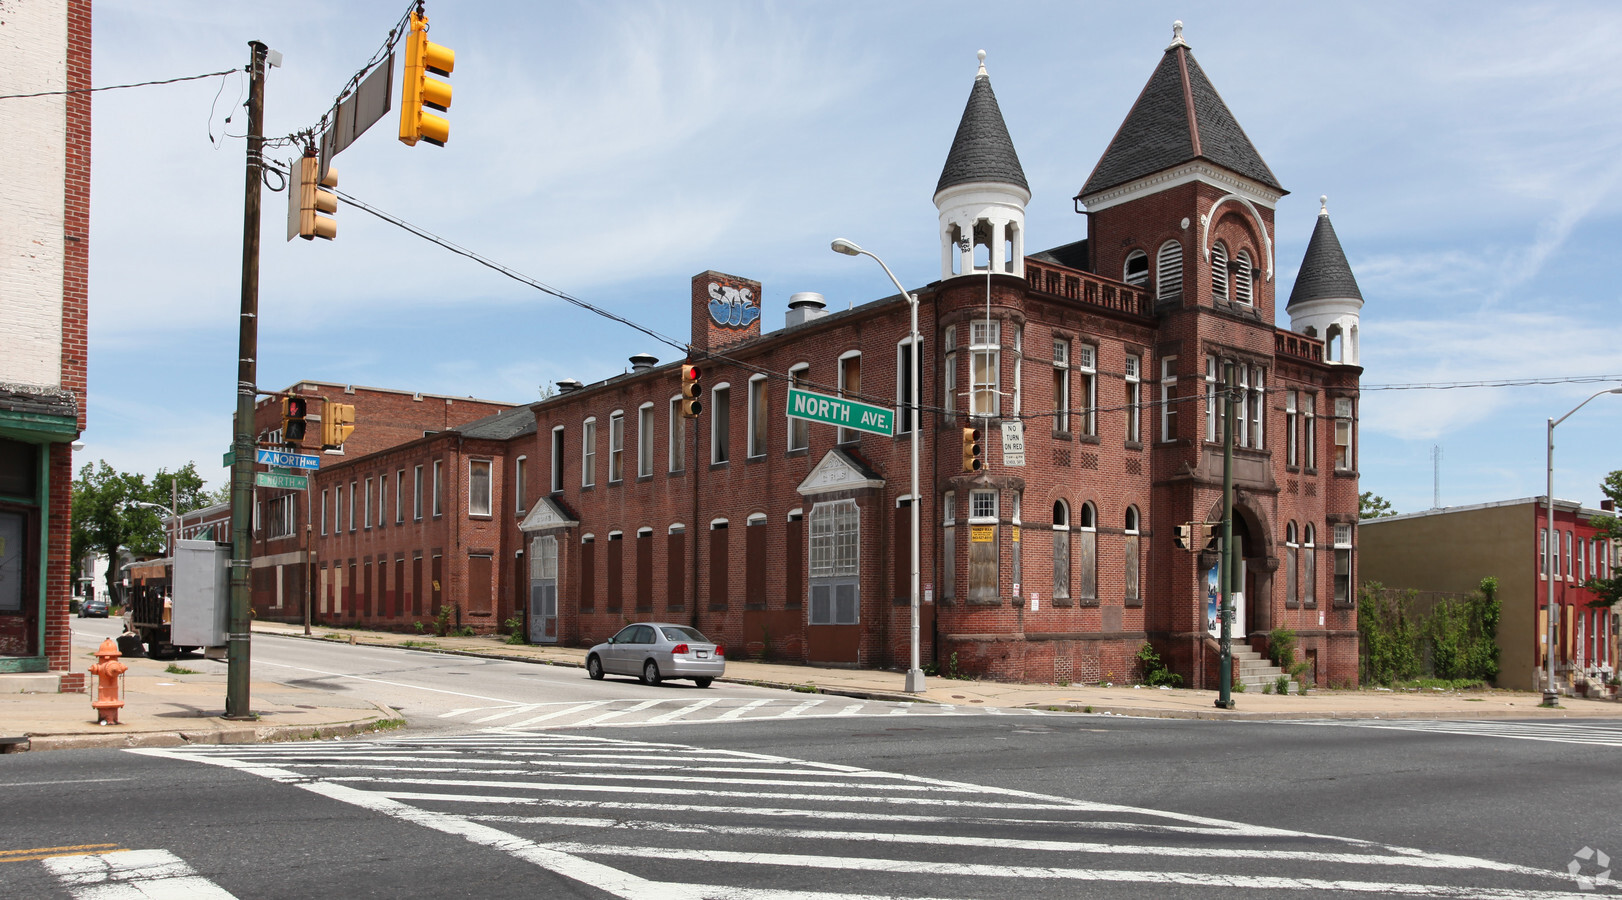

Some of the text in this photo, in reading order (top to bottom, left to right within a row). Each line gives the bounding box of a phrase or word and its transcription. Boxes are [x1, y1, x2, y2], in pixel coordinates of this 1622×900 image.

[794, 394, 889, 429] NORTH AVE.
[273, 453, 306, 467] NORTH
[267, 476, 295, 487] NORTH
